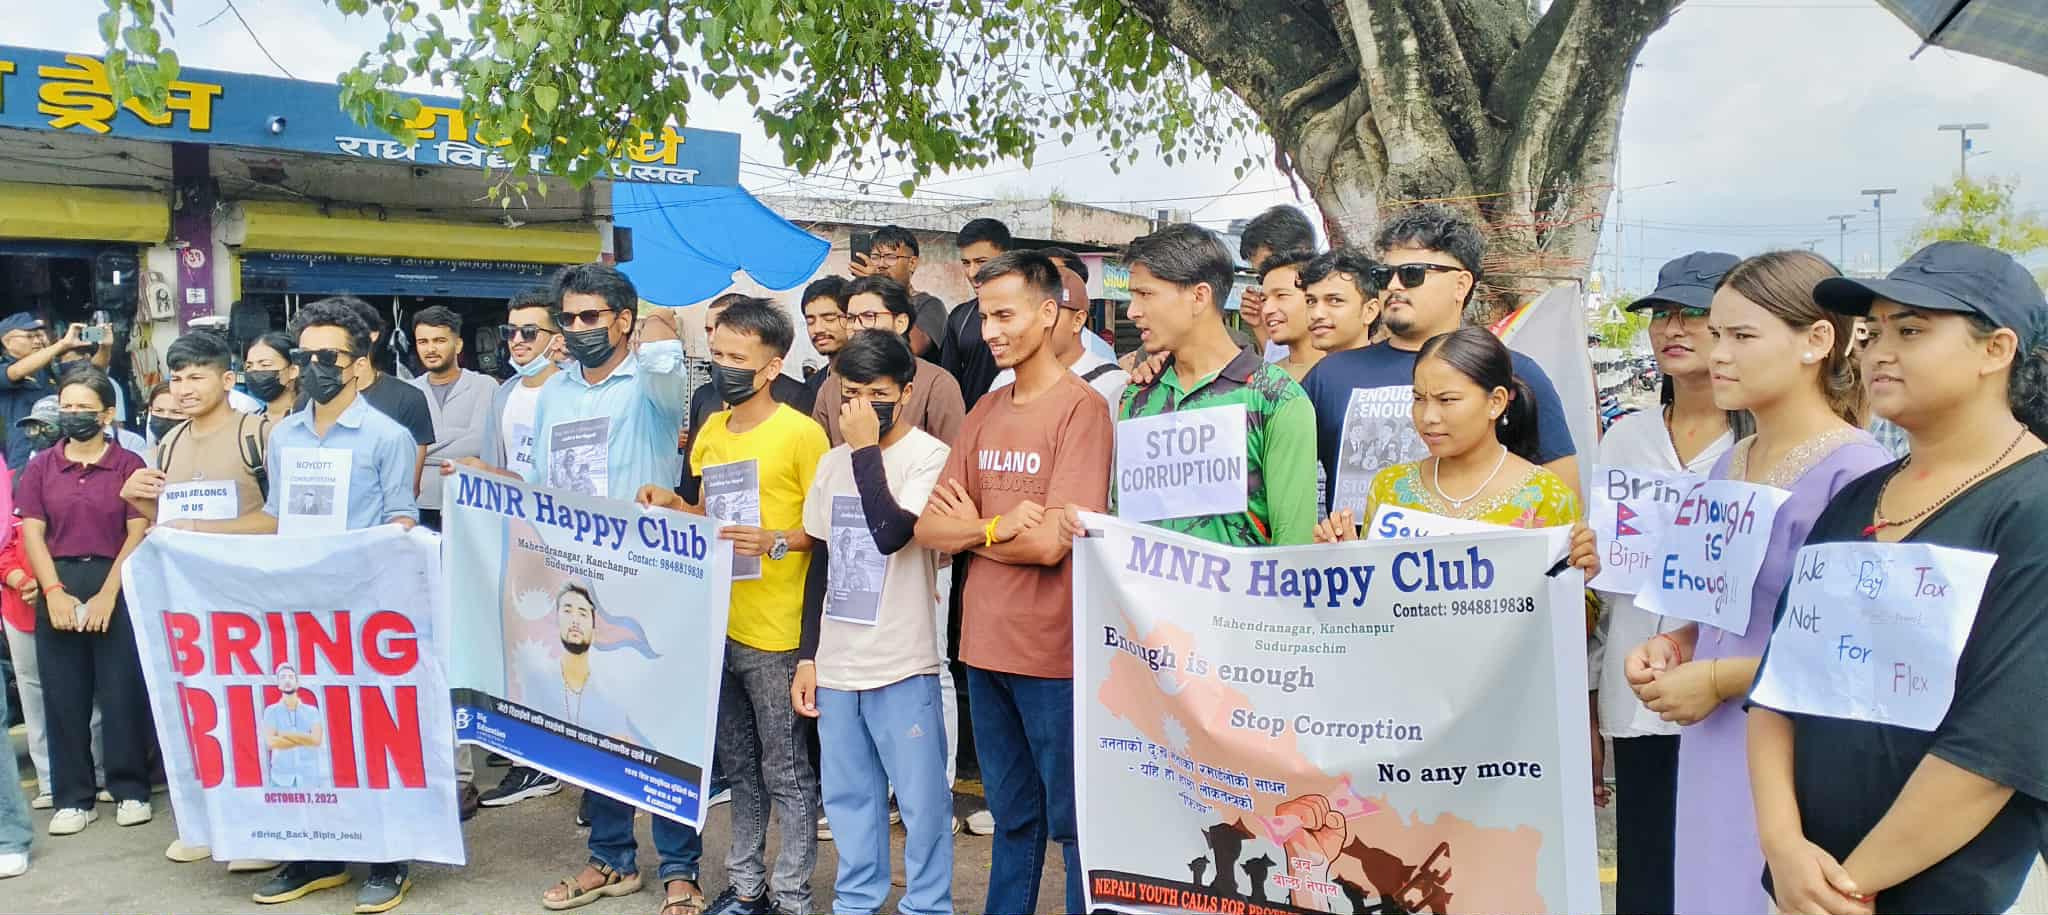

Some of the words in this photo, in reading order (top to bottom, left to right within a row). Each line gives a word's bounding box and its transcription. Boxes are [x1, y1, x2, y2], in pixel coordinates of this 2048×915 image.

[1358, 389, 1413, 402] ENOUG
[1145, 423, 1216, 460] STOP
[978, 449, 1041, 474] MILANO
[1121, 456, 1241, 493] CORRUPTION
[189, 487, 228, 498] BELONGS
[1342, 479, 1368, 493] STO
[1608, 469, 1680, 504] Brin
[192, 504, 204, 512] US
[456, 472, 526, 519] MNR
[532, 491, 628, 550] Happy
[637, 515, 708, 561] Club
[1674, 481, 1756, 546] Enough
[517, 538, 583, 566] Mahendranagar,
[586, 556, 640, 577] Kanchanpur
[544, 556, 605, 580] Sudurpaschim
[628, 551, 659, 569] Contact:
[1126, 535, 1231, 593] MNR
[1246, 559, 1376, 607] Happy
[1391, 546, 1495, 593] Club
[1797, 551, 1825, 585] We
[1857, 559, 1884, 600] Pay
[1914, 566, 1950, 598] Tax
[1393, 602, 1447, 618] Contact:
[1451, 597, 1535, 616] 9848819838
[1788, 604, 1822, 634] Not
[1212, 616, 1316, 637] Mahendranagar,
[1320, 623, 1395, 637] Kanchanpur
[161, 610, 419, 677] BRING
[1254, 639, 1346, 655] Sudurpaschim
[1838, 634, 1873, 665] For
[1104, 625, 1177, 671] Enough
[1186, 651, 1208, 675] is
[1218, 664, 1314, 693] enough
[1893, 662, 1929, 694] Flex
[1231, 708, 1284, 737] Stop
[1293, 715, 1424, 744] Corroption
[1100, 736, 1142, 753] जनताको
[1378, 763, 1412, 783] No
[1421, 766, 1466, 786] any
[1477, 761, 1542, 780] more
[264, 793, 306, 804] OCTOBER
[315, 793, 338, 804] 2023
[1095, 878, 1136, 898] NEPALI
[1139, 884, 1177, 907] YOUTH
[1181, 890, 1218, 912] CALLS
[1220, 898, 1245, 915] FOR
